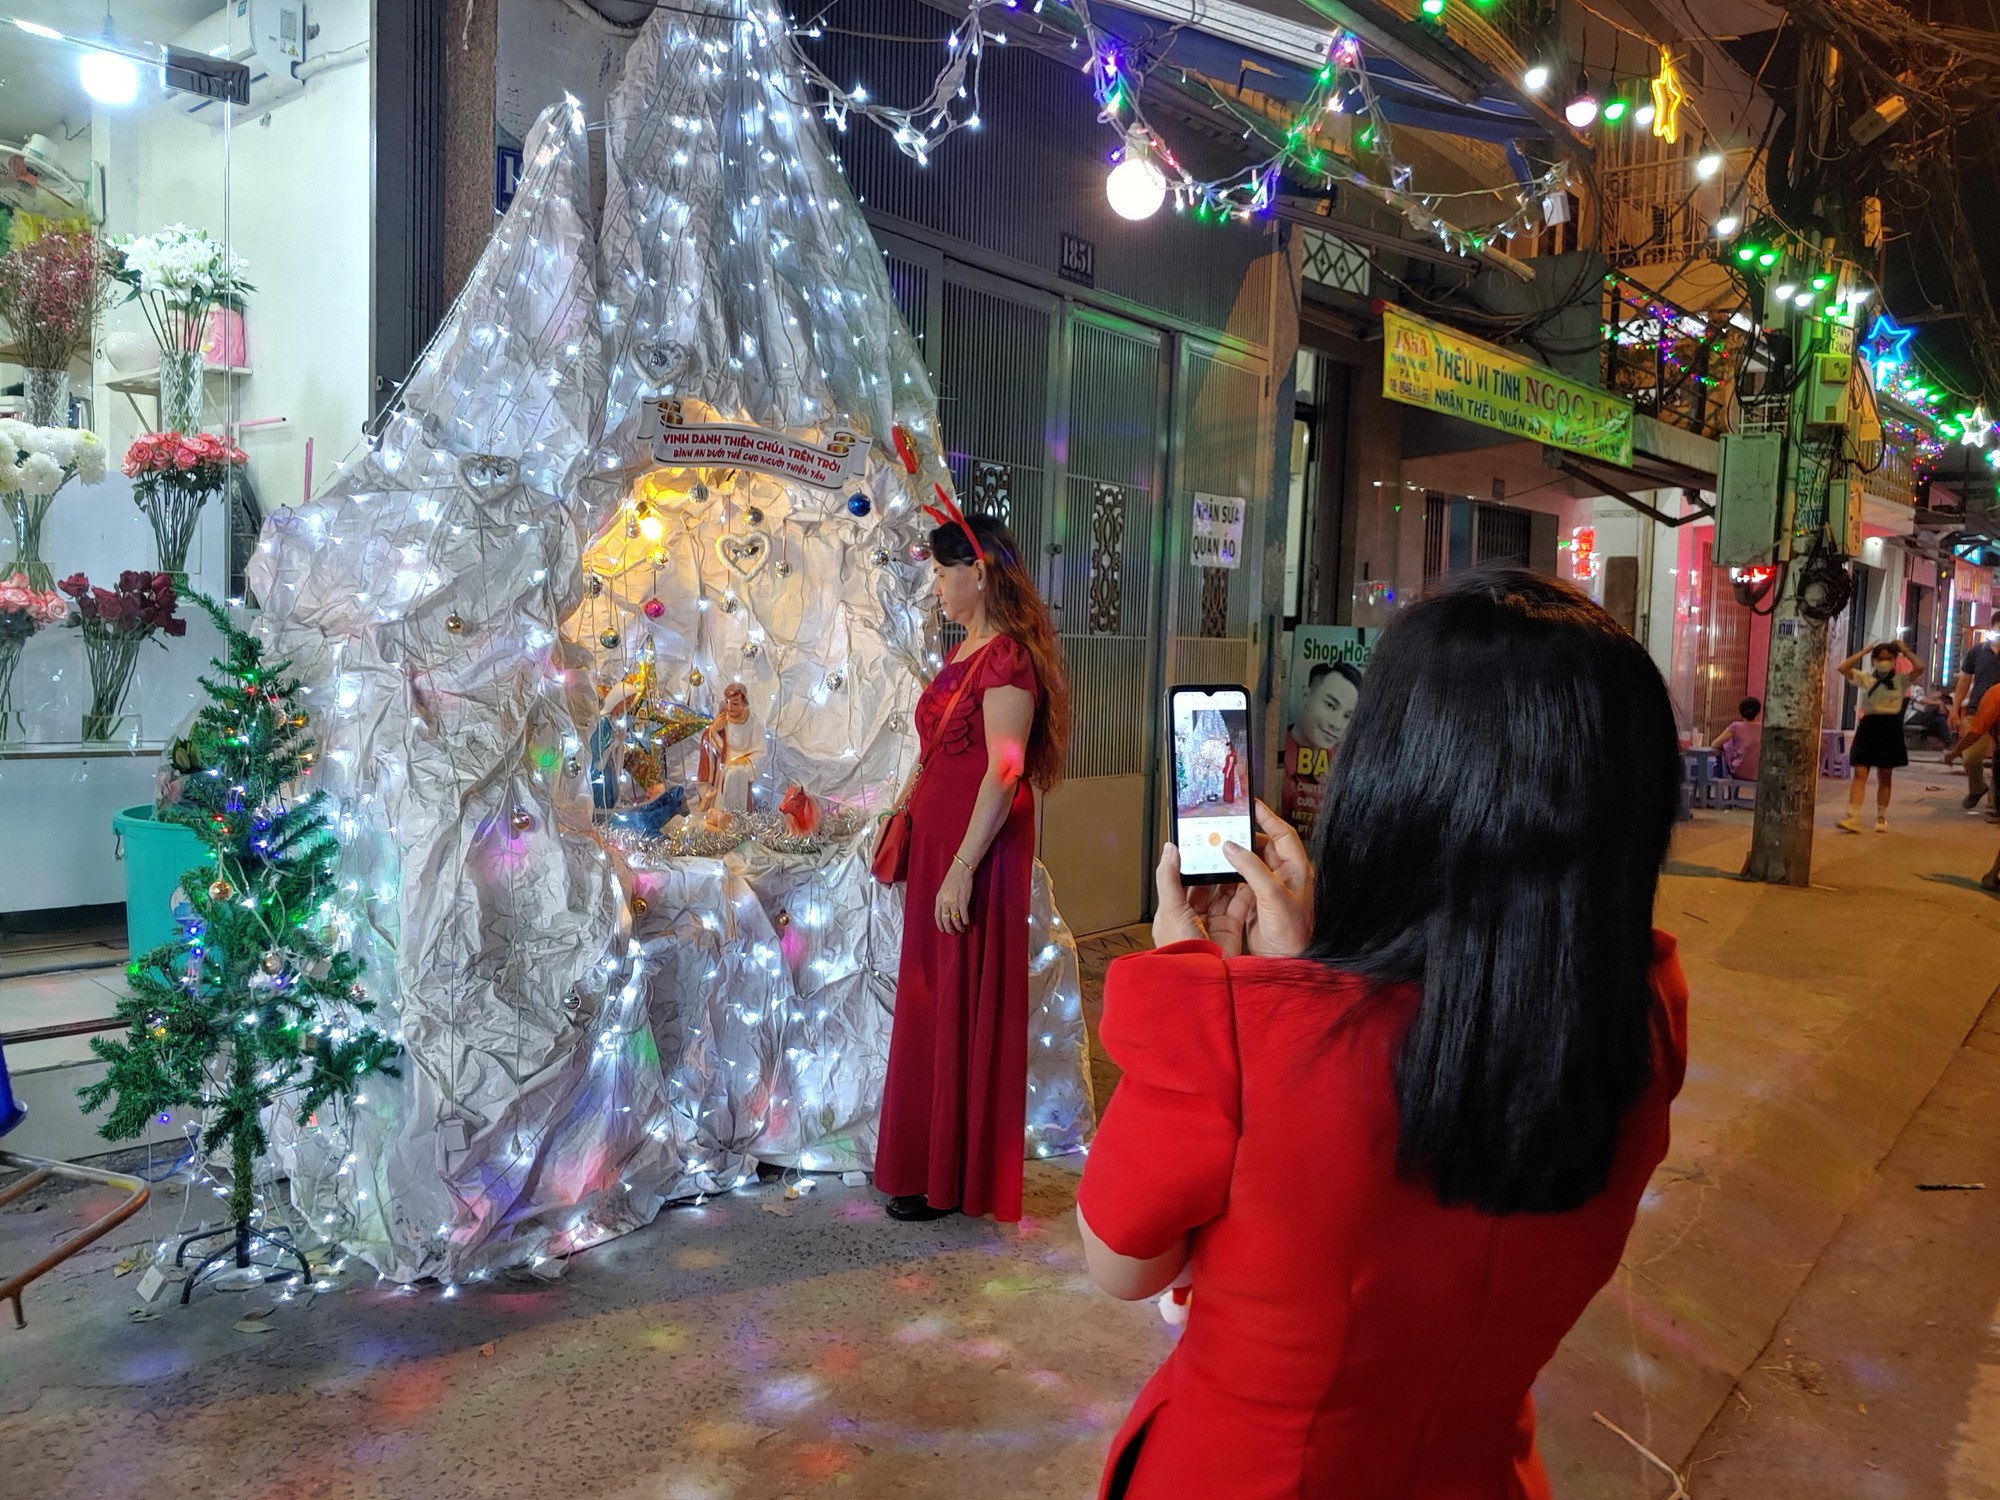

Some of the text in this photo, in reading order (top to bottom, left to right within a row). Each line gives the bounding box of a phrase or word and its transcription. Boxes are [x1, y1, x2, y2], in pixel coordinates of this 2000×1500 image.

[1063, 237, 1092, 274] 1851
[1476, 362, 1488, 392] VI
[1492, 365, 1520, 402] TÍNH
[1525, 376, 1585, 423] NGỌC
[663, 434, 689, 445] VINH
[692, 434, 721, 445] DANH
[724, 435, 754, 449] THIÊN
[756, 440, 785, 455] CHÚA
[788, 447, 814, 464] TRÊN
[673, 447, 693, 458] BÌNH
[694, 449, 706, 458] AN
[707, 447, 725, 458] DƯỚI
[743, 453, 759, 462] CHO
[760, 455, 785, 468] NGƯỜI
[810, 469, 826, 482] TÂM
[1222, 532, 1236, 558] ÁO
[1303, 637, 1339, 666] Shop
